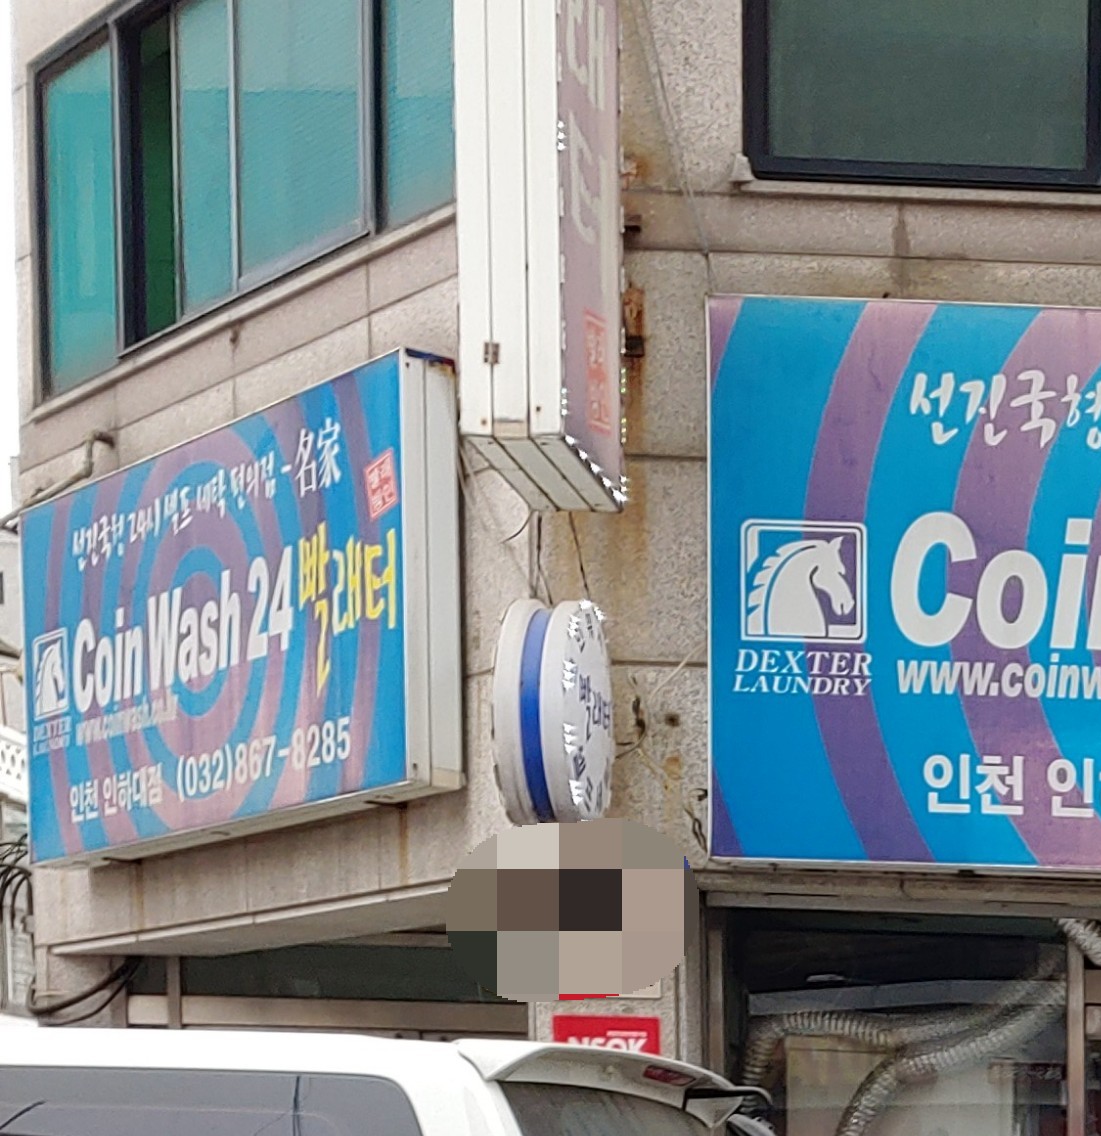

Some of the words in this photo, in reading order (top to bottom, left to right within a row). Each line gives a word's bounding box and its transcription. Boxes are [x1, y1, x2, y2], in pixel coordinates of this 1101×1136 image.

[73, 608, 142, 714] Coin
[148, 568, 241, 689] Wash
[247, 545, 295, 661] 24
[298, 520, 398, 699] 빨래터
[732, 673, 873, 697] LAUNDRY
[734, 648, 873, 677] DEXTER
[177, 716, 352, 803] (032)867-8285
[923, 752, 1025, 817] 인천
[69, 778, 99, 824] 인천
[102, 761, 164, 817] 인하대점
